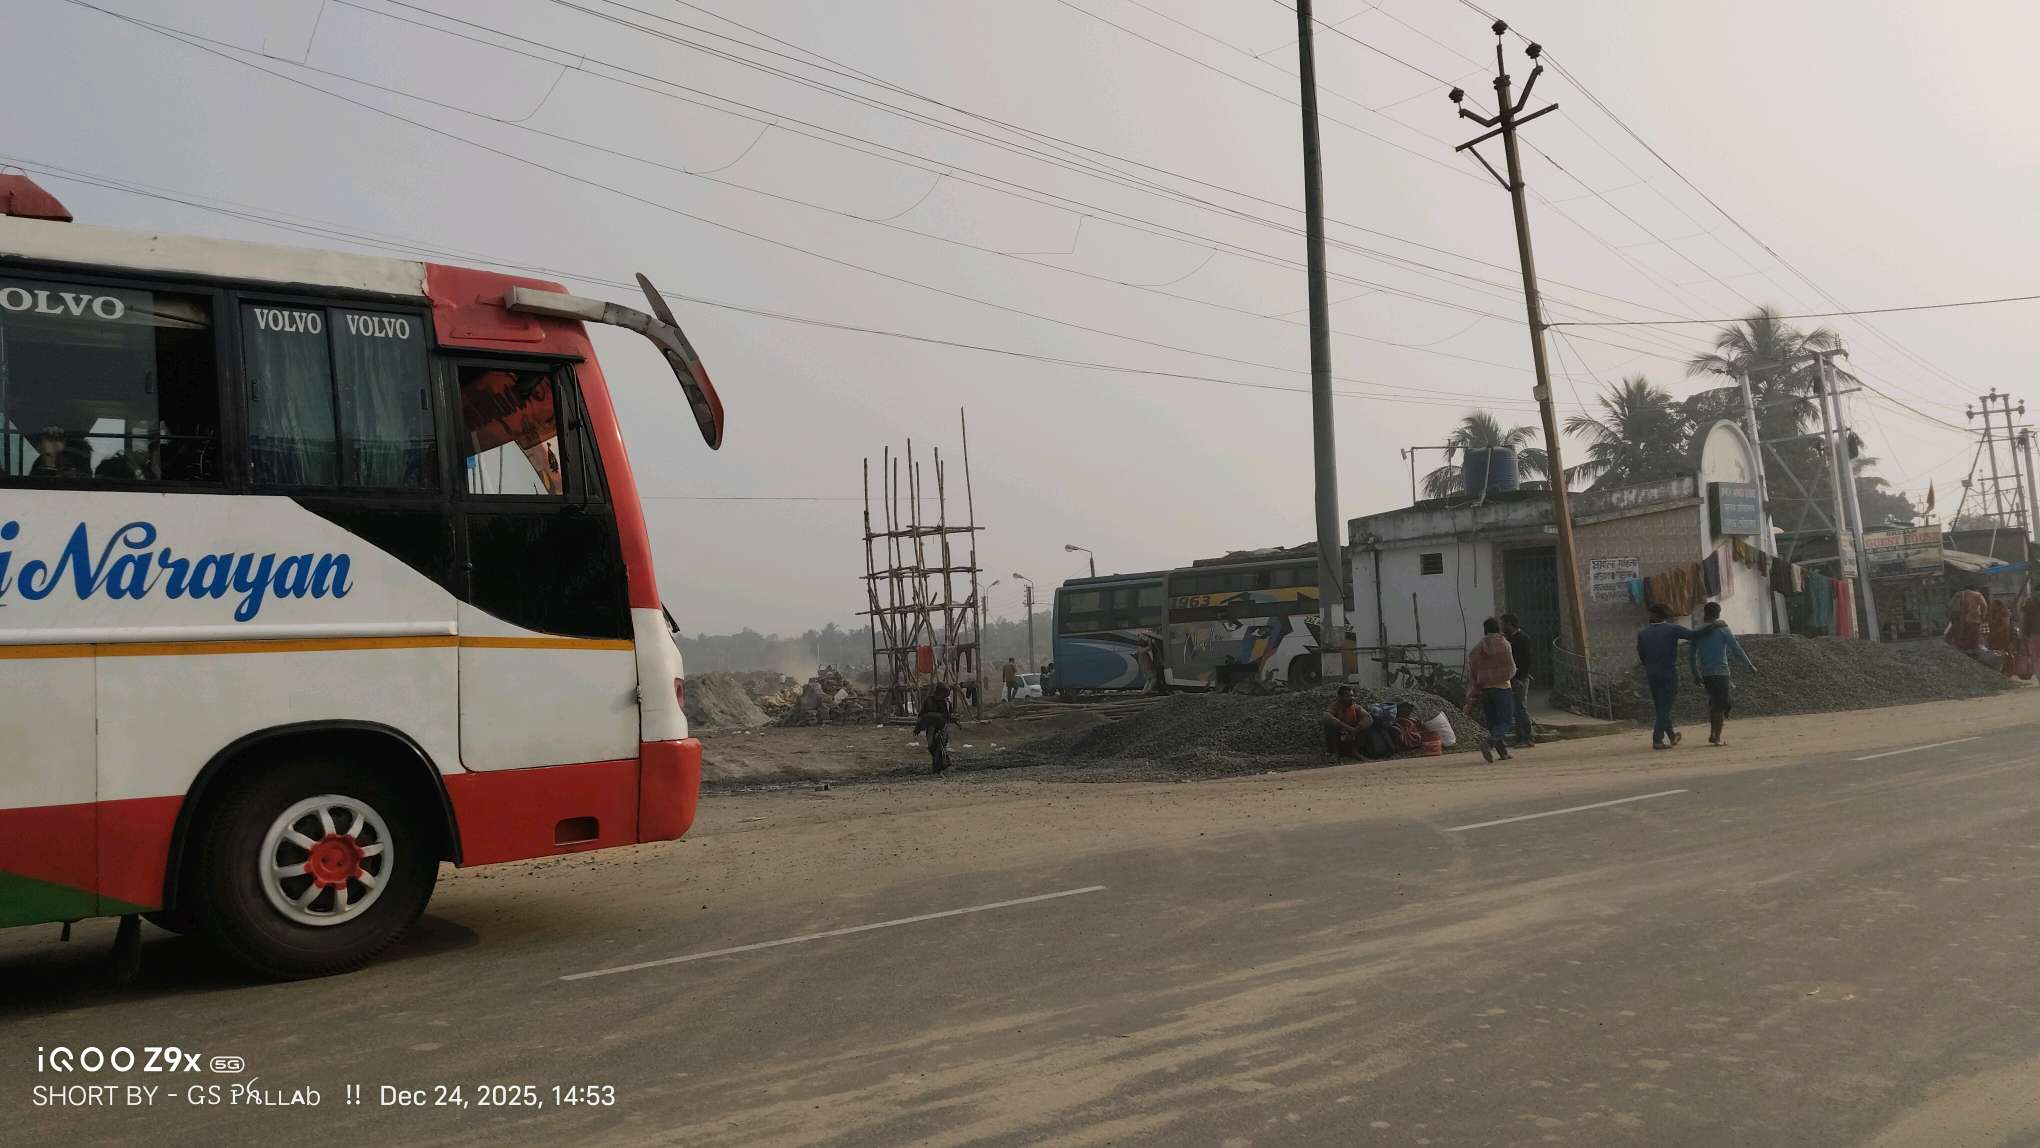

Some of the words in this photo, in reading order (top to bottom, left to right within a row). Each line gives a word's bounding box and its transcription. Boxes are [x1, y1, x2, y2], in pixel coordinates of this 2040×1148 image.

[253, 308, 322, 334] VOLVO
[346, 314, 410, 339] VOLVO
[17, 521, 354, 622] Narayan
